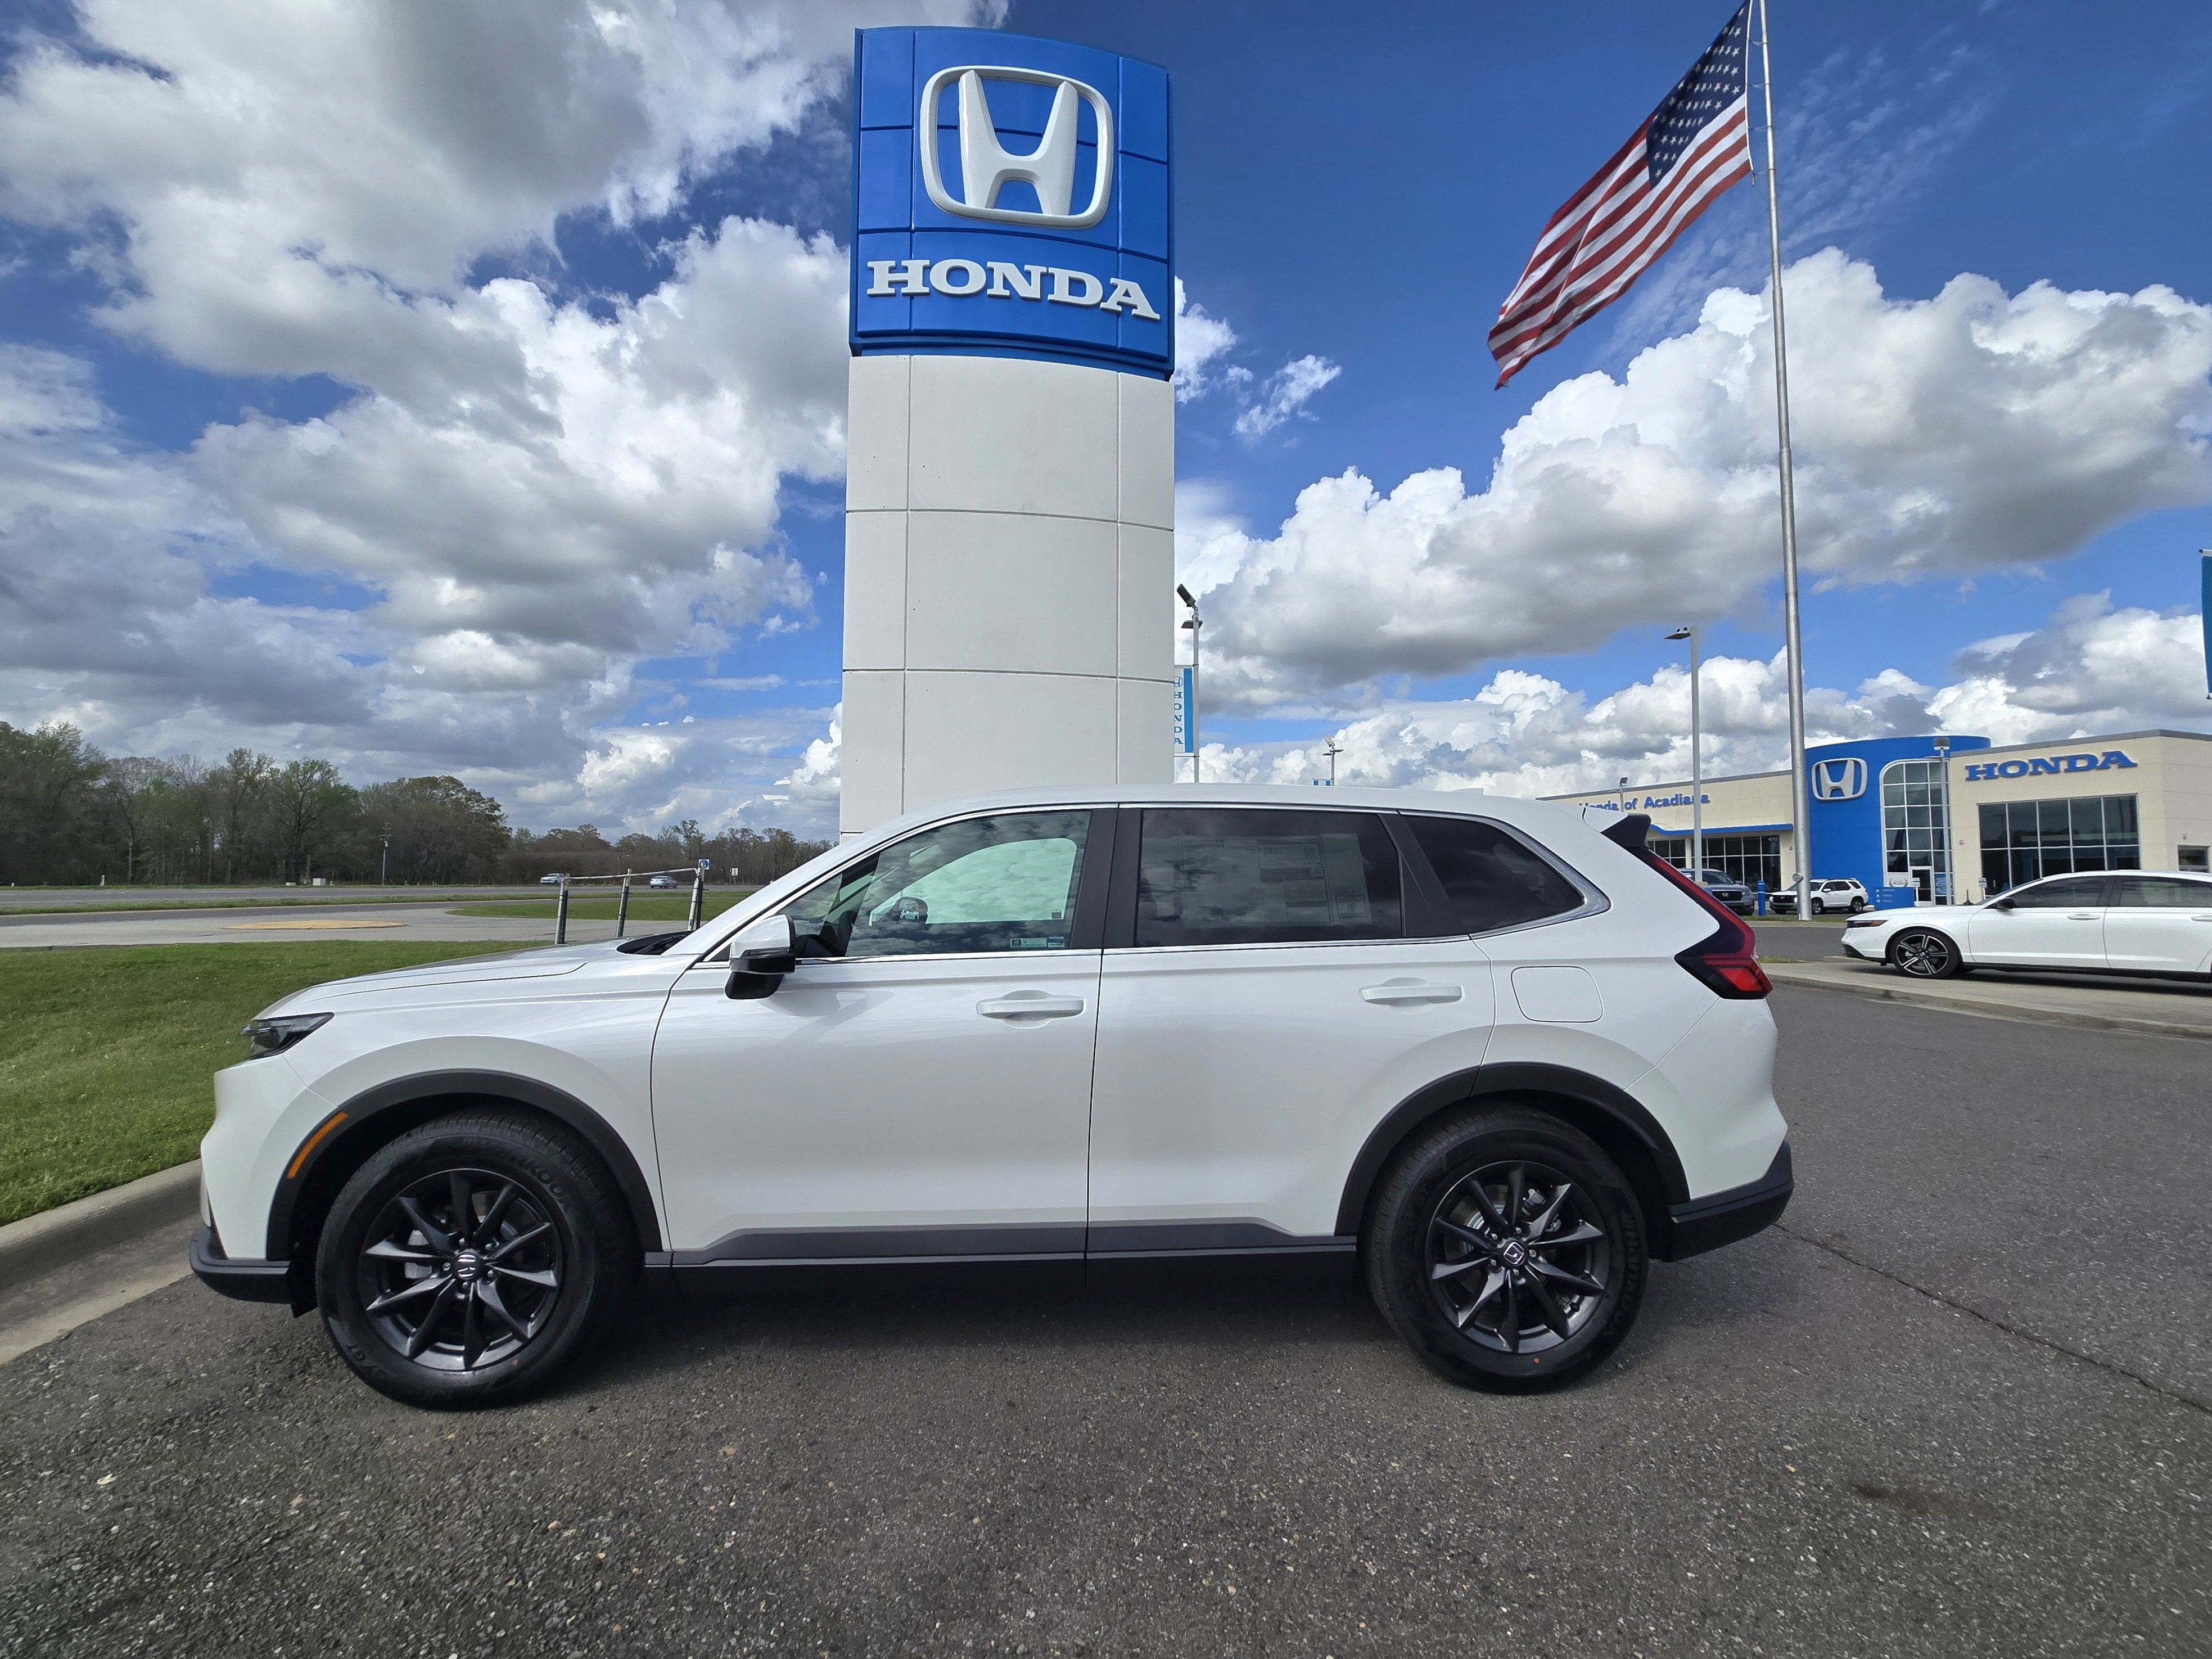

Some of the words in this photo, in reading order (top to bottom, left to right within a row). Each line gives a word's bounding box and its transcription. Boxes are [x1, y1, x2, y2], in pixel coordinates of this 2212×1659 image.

[866, 259, 1160, 320] HONDA
[1965, 750, 2138, 781] HONDA
[1579, 800, 1619, 811] nda
[1624, 797, 1638, 810] of
[1644, 794, 1710, 809] Acadiaa
